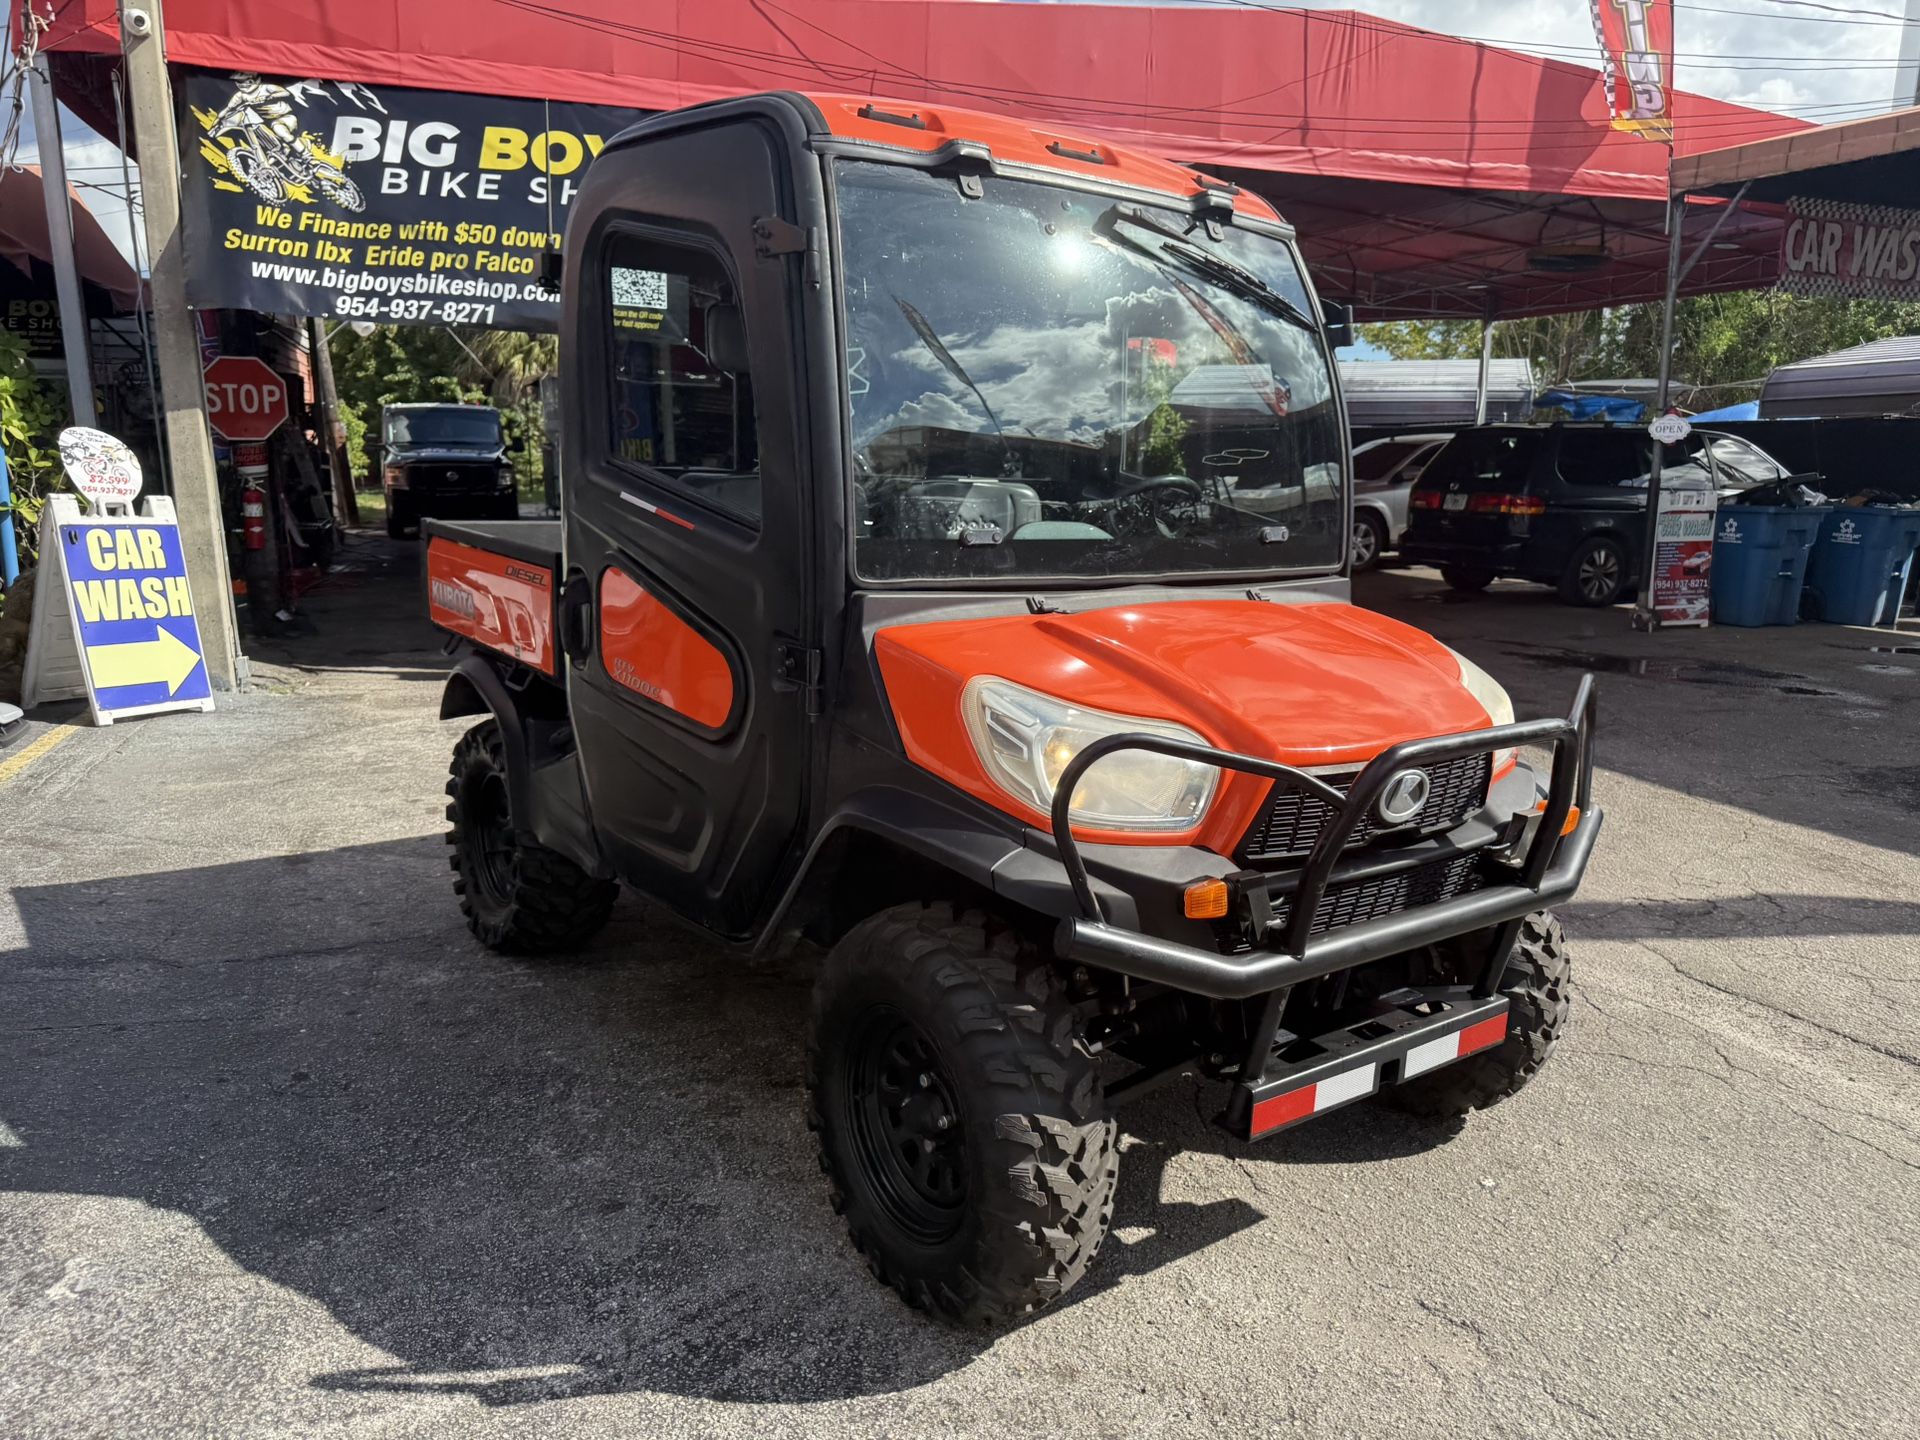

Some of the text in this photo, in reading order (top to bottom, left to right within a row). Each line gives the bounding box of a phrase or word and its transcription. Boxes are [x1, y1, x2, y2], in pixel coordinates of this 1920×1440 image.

[331, 115, 461, 168] BIG
[380, 167, 502, 201] BIKE
[256, 205, 562, 250] We Finance with $50 down
[224, 228, 309, 258] Surron
[365, 246, 424, 268] Eride
[430, 254, 469, 274] pro
[474, 253, 535, 275] Falco
[1785, 219, 1920, 281] CAR WAS
[335, 294, 496, 325] 954-937-8271
[206, 382, 281, 414] STOP
[1655, 425, 1684, 434] OPEN
[85, 528, 167, 572] CAR
[505, 565, 547, 586] DIESEL
[1654, 578, 1708, 590] (954) 937-8271
[72, 576, 193, 624] WASH
[432, 579, 476, 618] KUBOTA
